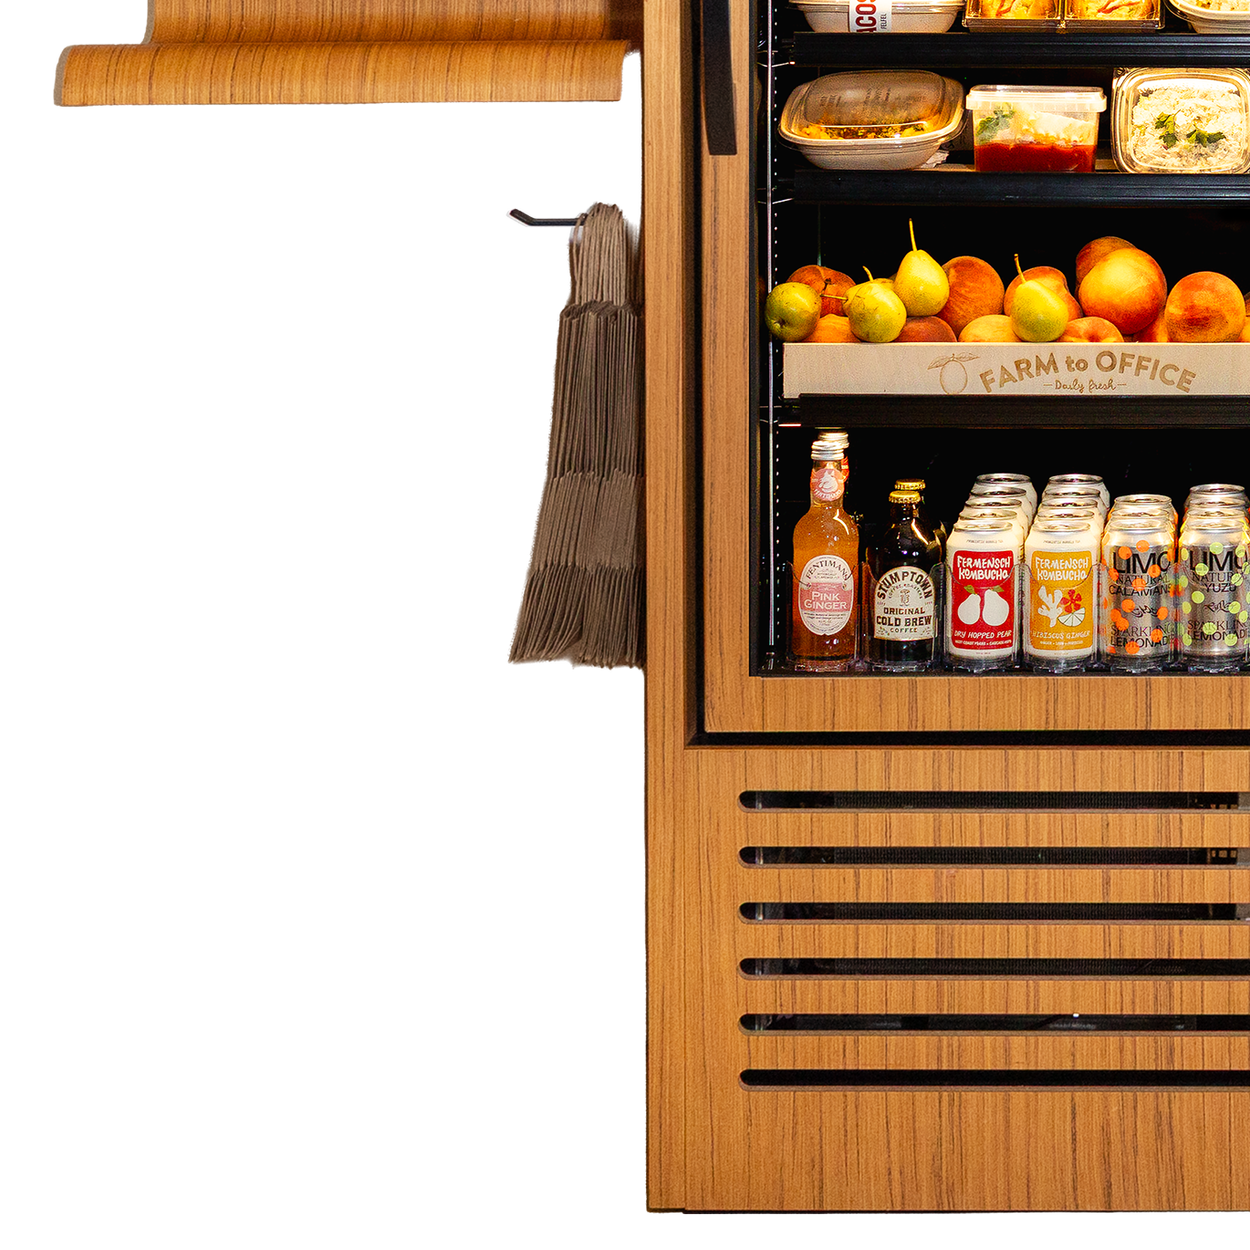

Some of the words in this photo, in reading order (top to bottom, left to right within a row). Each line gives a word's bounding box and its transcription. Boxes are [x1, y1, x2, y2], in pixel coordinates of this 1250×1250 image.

[979, 352, 1060, 393] FARM
[1065, 356, 1089, 372] to
[1095, 350, 1197, 393] OFFICE
[1054, 378, 1085, 393] Daily
[1088, 378, 1117, 393] fresh
[957, 556, 1011, 568] FERMENSCH
[1035, 556, 1089, 568] FERMENSCH
[1112, 551, 1172, 574] LIMO
[806, 560, 849, 581] FENTIMANS
[876, 571, 933, 600] STUMPTOWN
[1204, 583, 1237, 593] YUZU
[811, 591, 840, 600] PINK
[804, 599, 848, 610] GINGER
[883, 607, 926, 616] ORIGINAL
[876, 616, 902, 626] COLD
[904, 615, 932, 626] BREW
[954, 630, 966, 639] DRY
[996, 630, 1012, 638] PEAR
[1032, 630, 1064, 640] HIBISCUS
[1066, 630, 1090, 639] GINGER
